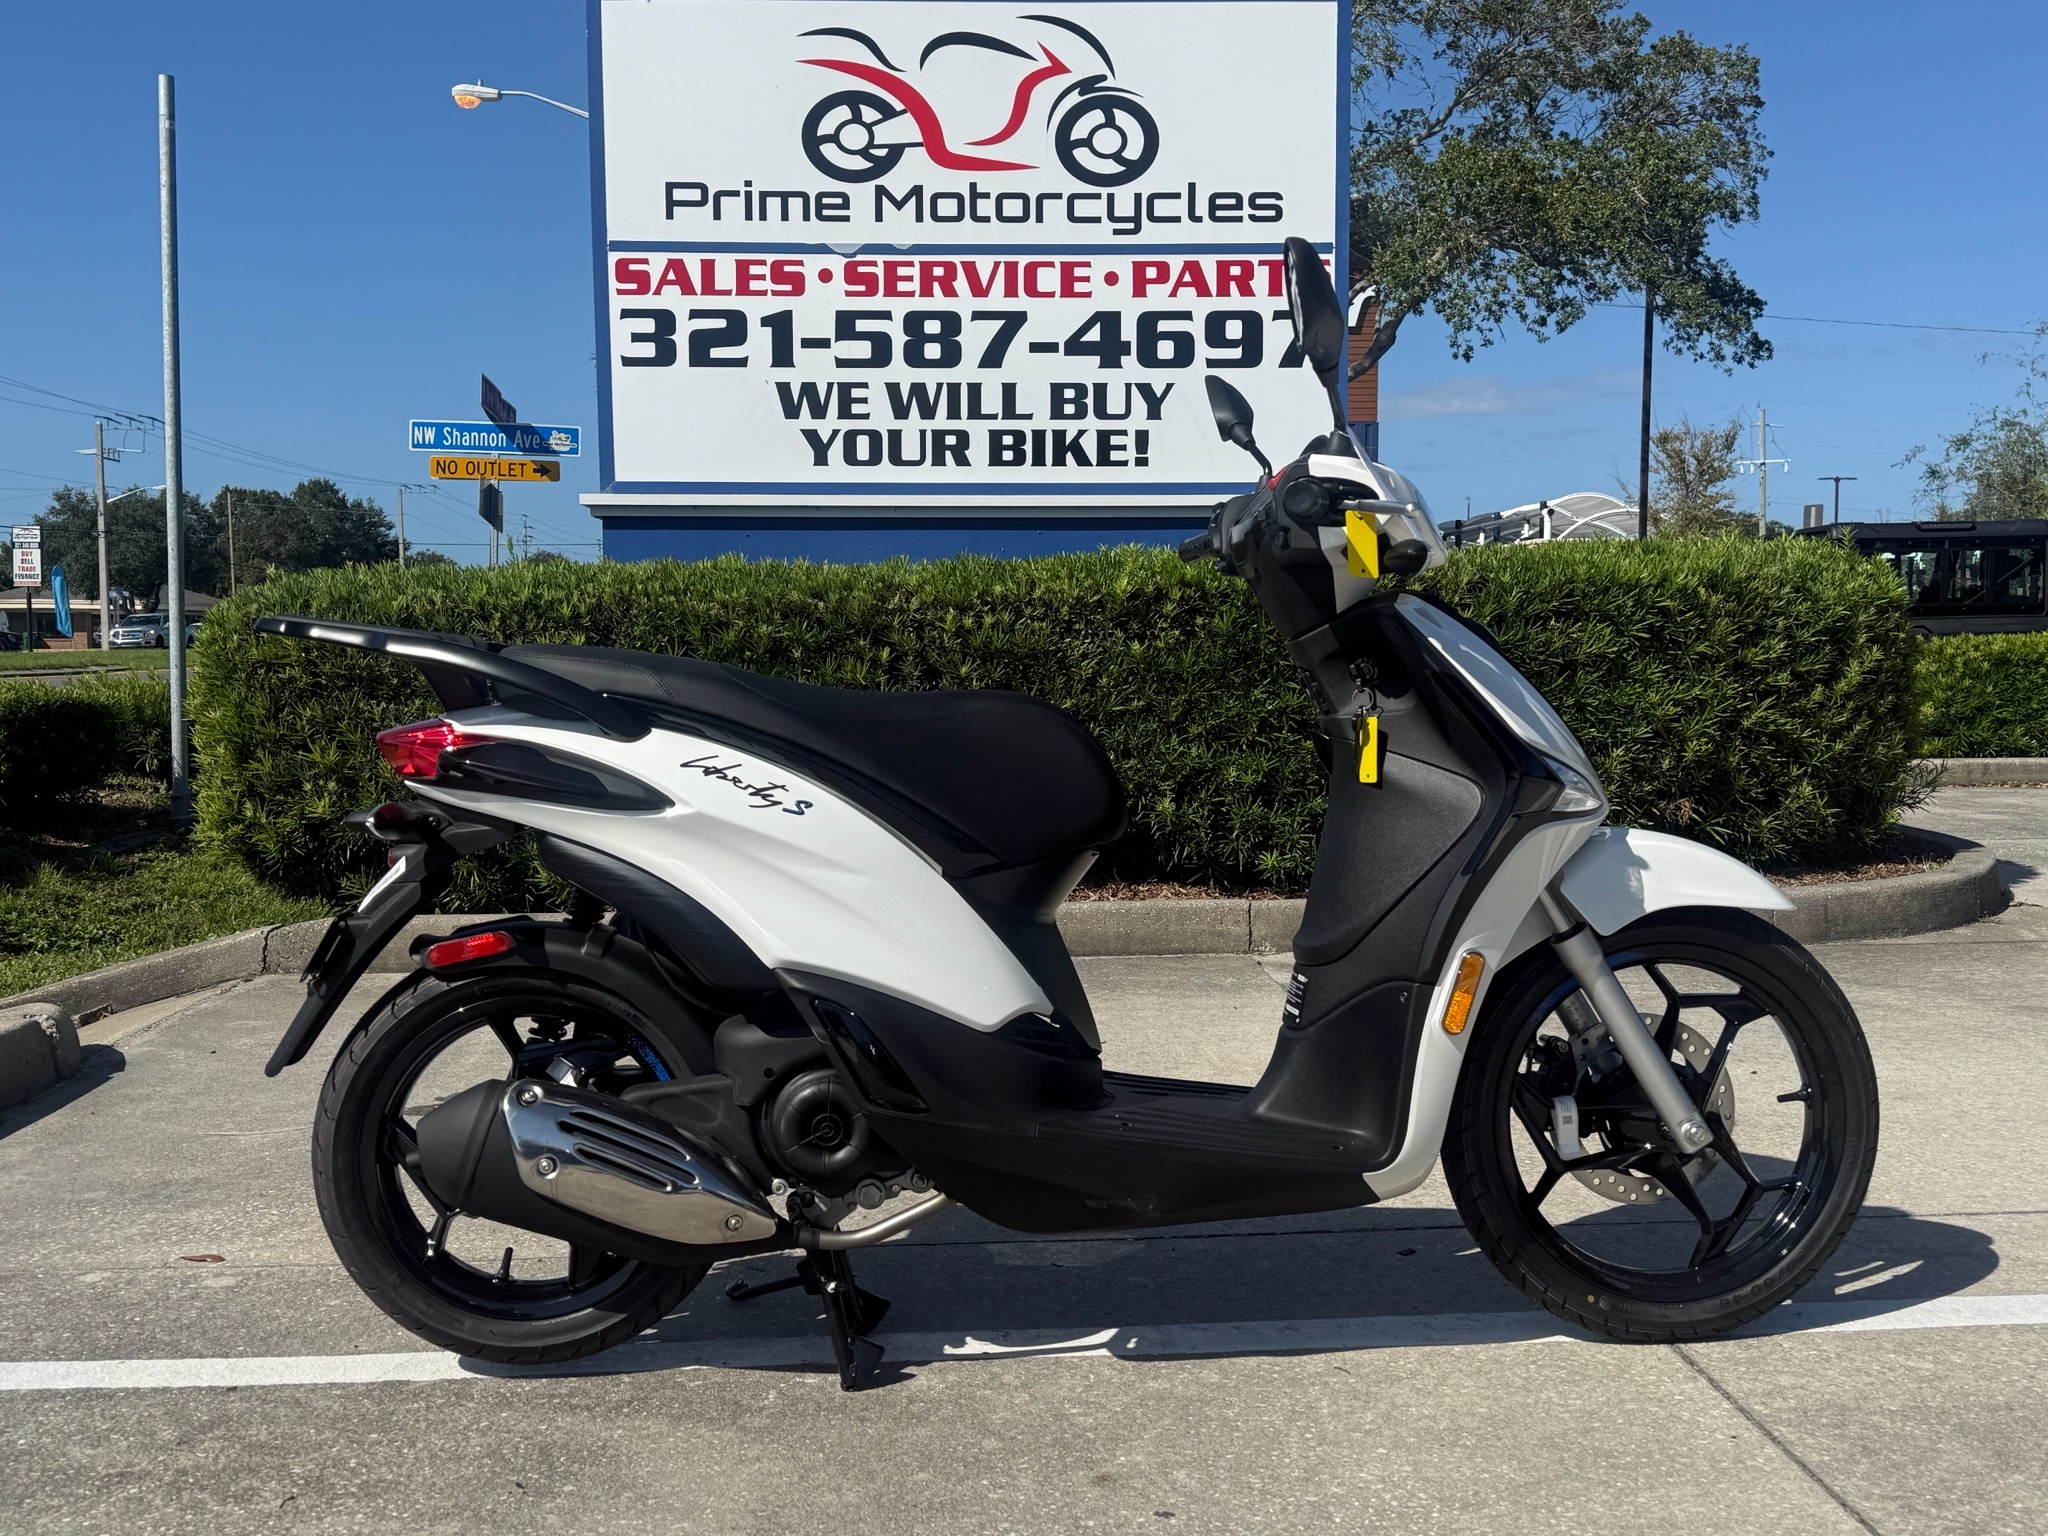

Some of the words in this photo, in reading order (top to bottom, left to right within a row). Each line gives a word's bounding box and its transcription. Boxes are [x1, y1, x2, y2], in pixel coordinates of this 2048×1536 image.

[665, 181, 851, 223] Prime
[874, 182, 1284, 237] Motorcycles
[614, 257, 806, 297] SALES
[843, 259, 1093, 298] SERVICE
[1131, 259, 1331, 299] PART
[774, 381, 870, 421] WE
[884, 381, 1034, 421] WILL
[1049, 382, 1176, 421] BUY
[413, 426, 436, 445] NW
[442, 427, 506, 448] Shannon
[514, 429, 540, 449] Ave
[799, 428, 972, 467] YOUR
[987, 429, 1151, 467] BIKE!
[435, 459, 458, 475] NO
[465, 460, 527, 478] OUTLET
